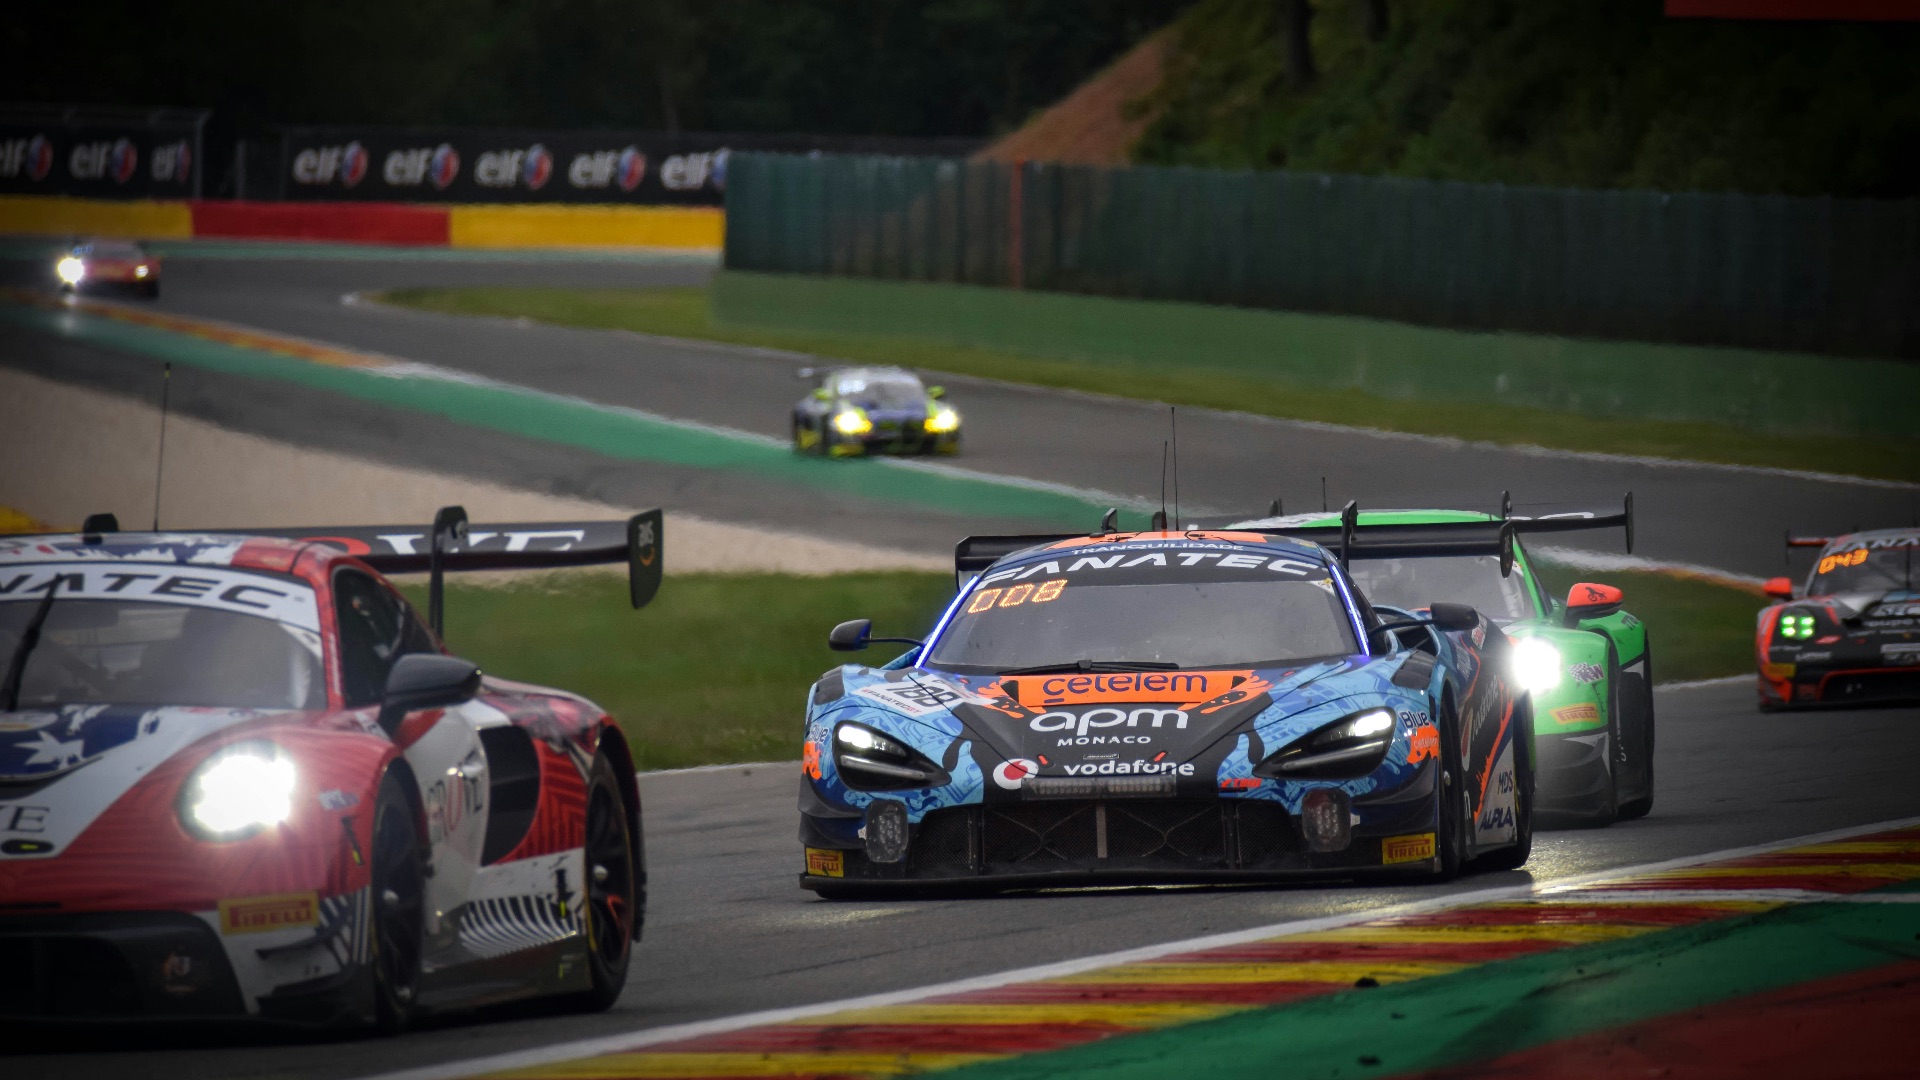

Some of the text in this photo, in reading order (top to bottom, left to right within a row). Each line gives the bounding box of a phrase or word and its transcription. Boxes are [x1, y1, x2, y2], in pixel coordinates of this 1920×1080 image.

[291, 145, 341, 185] elf
[382, 147, 433, 186] elf
[474, 149, 525, 188] elf
[567, 150, 619, 188] elf
[660, 152, 711, 190] elf
[1071, 543, 1245, 555] TRANQUILIDADE
[973, 552, 1321, 590] FANATEC
[967, 578, 1069, 615] 008
[1029, 708, 1189, 736] apm
[1399, 711, 1431, 729] Blue
[1057, 735, 1152, 747] MONACO
[1063, 759, 1195, 776] vodafone
[1387, 838, 1431, 860] PIRELLI
